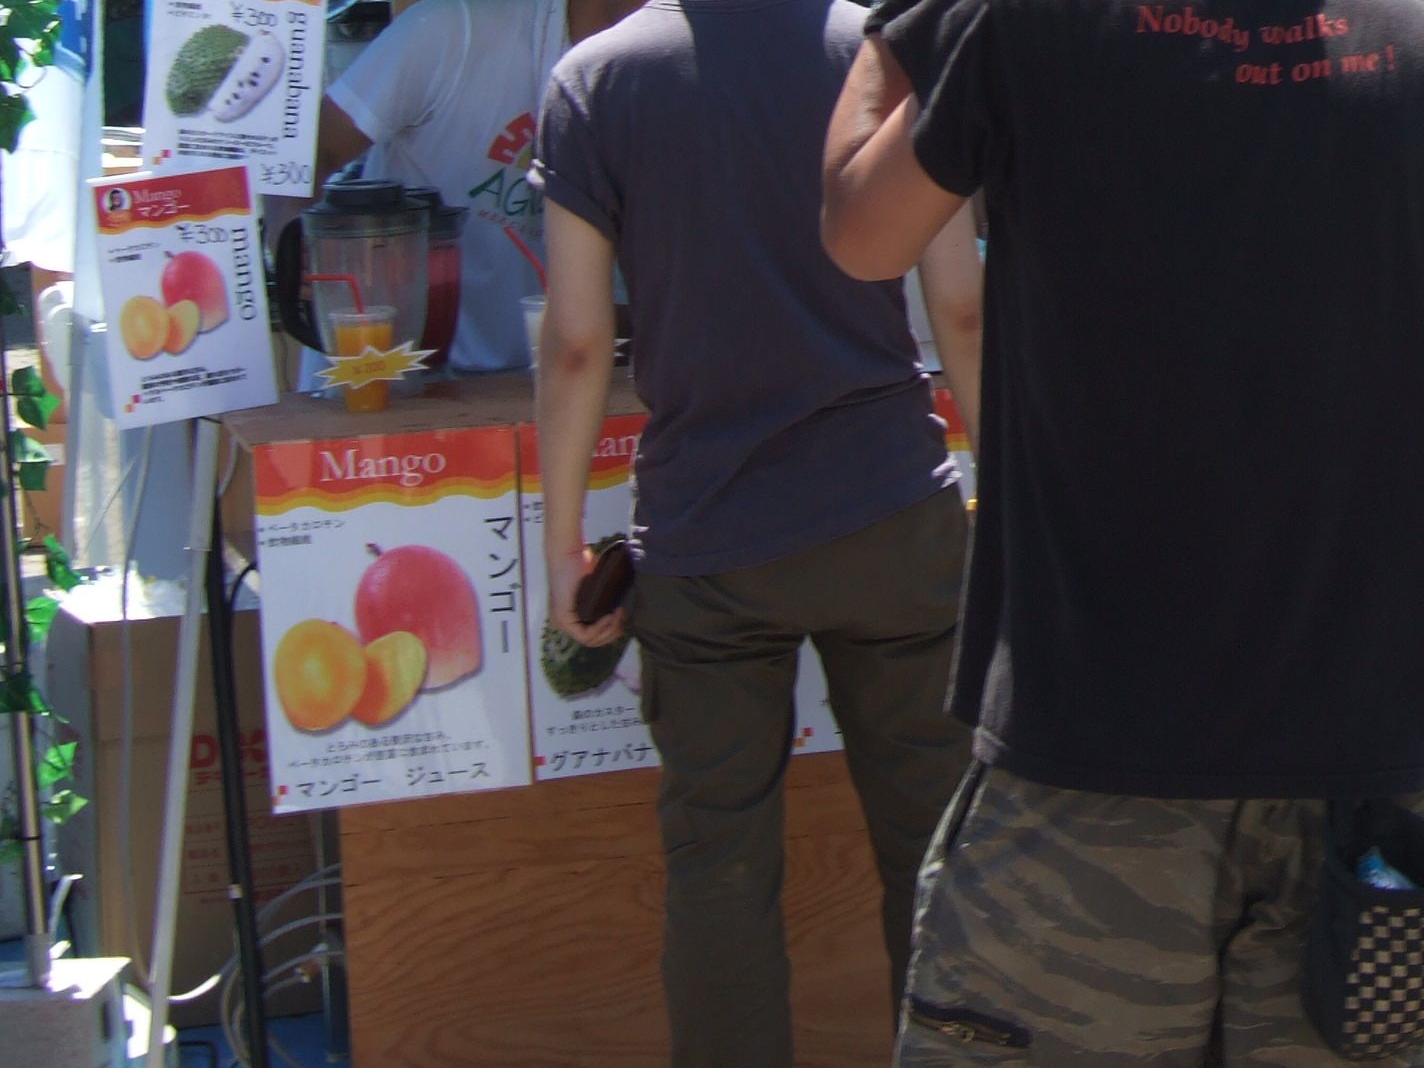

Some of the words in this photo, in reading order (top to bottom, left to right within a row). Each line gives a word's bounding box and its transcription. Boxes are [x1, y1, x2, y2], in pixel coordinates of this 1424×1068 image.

[1136, 3, 1249, 53] Nobody
[1260, 12, 1349, 45] walks
[283, 11, 311, 139] guanabana
[1235, 61, 1283, 85] out
[1291, 58, 1333, 82] on
[232, 227, 257, 321] mango
[319, 448, 447, 487] Mango
[483, 515, 521, 654] マンゴー
[296, 773, 382, 798] マンゴー
[406, 762, 490, 787] ジュース
